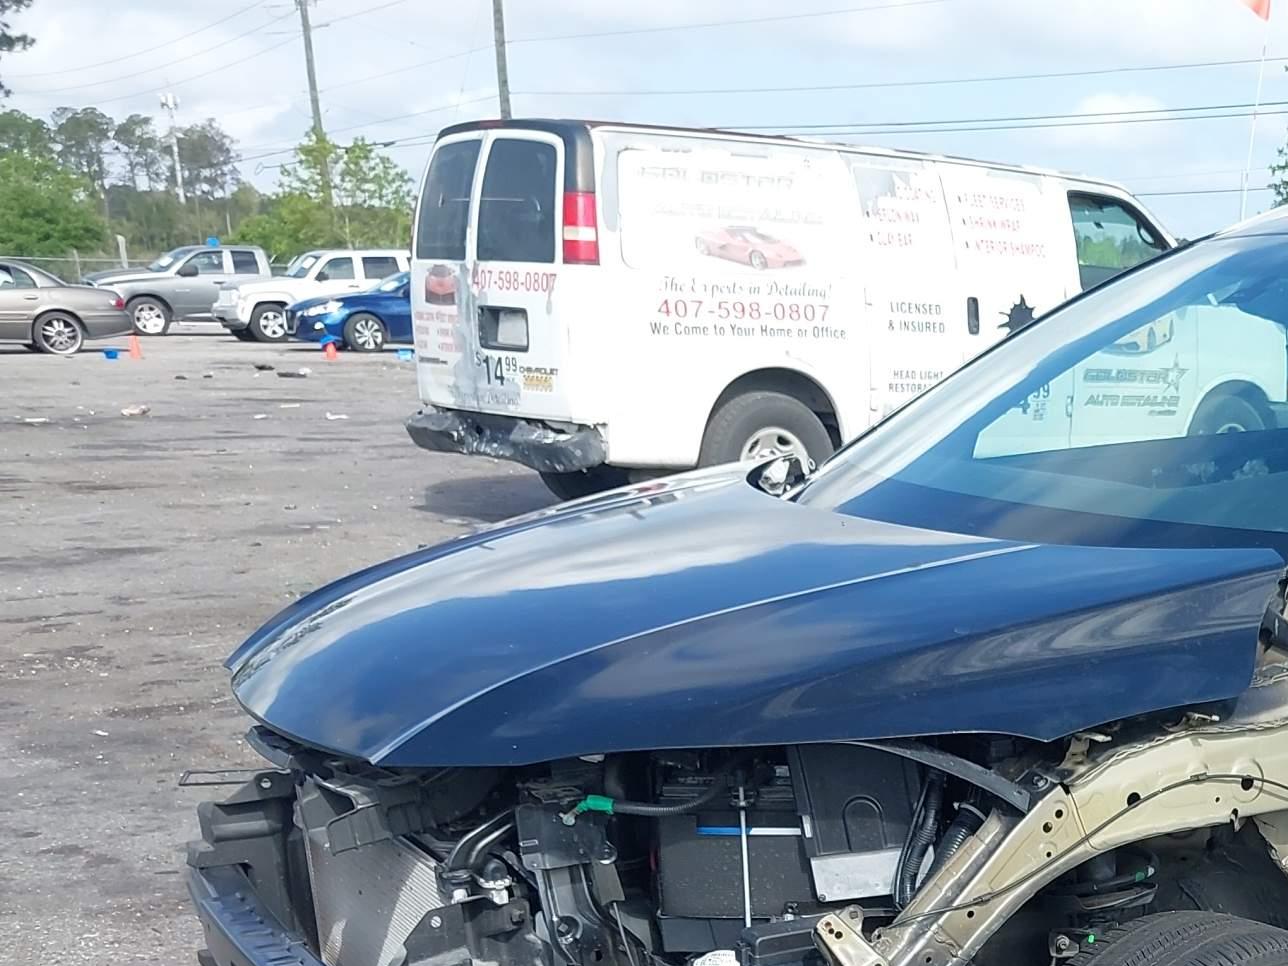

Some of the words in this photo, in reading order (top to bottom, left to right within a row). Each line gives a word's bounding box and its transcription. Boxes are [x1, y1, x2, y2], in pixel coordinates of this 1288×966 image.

[471, 269, 557, 293] 407-598-0807
[664, 275, 686, 293] The
[657, 299, 830, 322] 407-598-0807
[889, 301, 942, 315] LICENSED
[650, 322, 669, 336] We
[674, 322, 709, 337] Come
[714, 323, 725, 337] to
[730, 323, 755, 337] Your
[761, 325, 793, 338] Home
[798, 327, 808, 338] or
[888, 320, 895, 331] &
[899, 320, 945, 334] INSURED
[893, 369, 917, 380] HEAD
[920, 370, 944, 380] LIGHT
